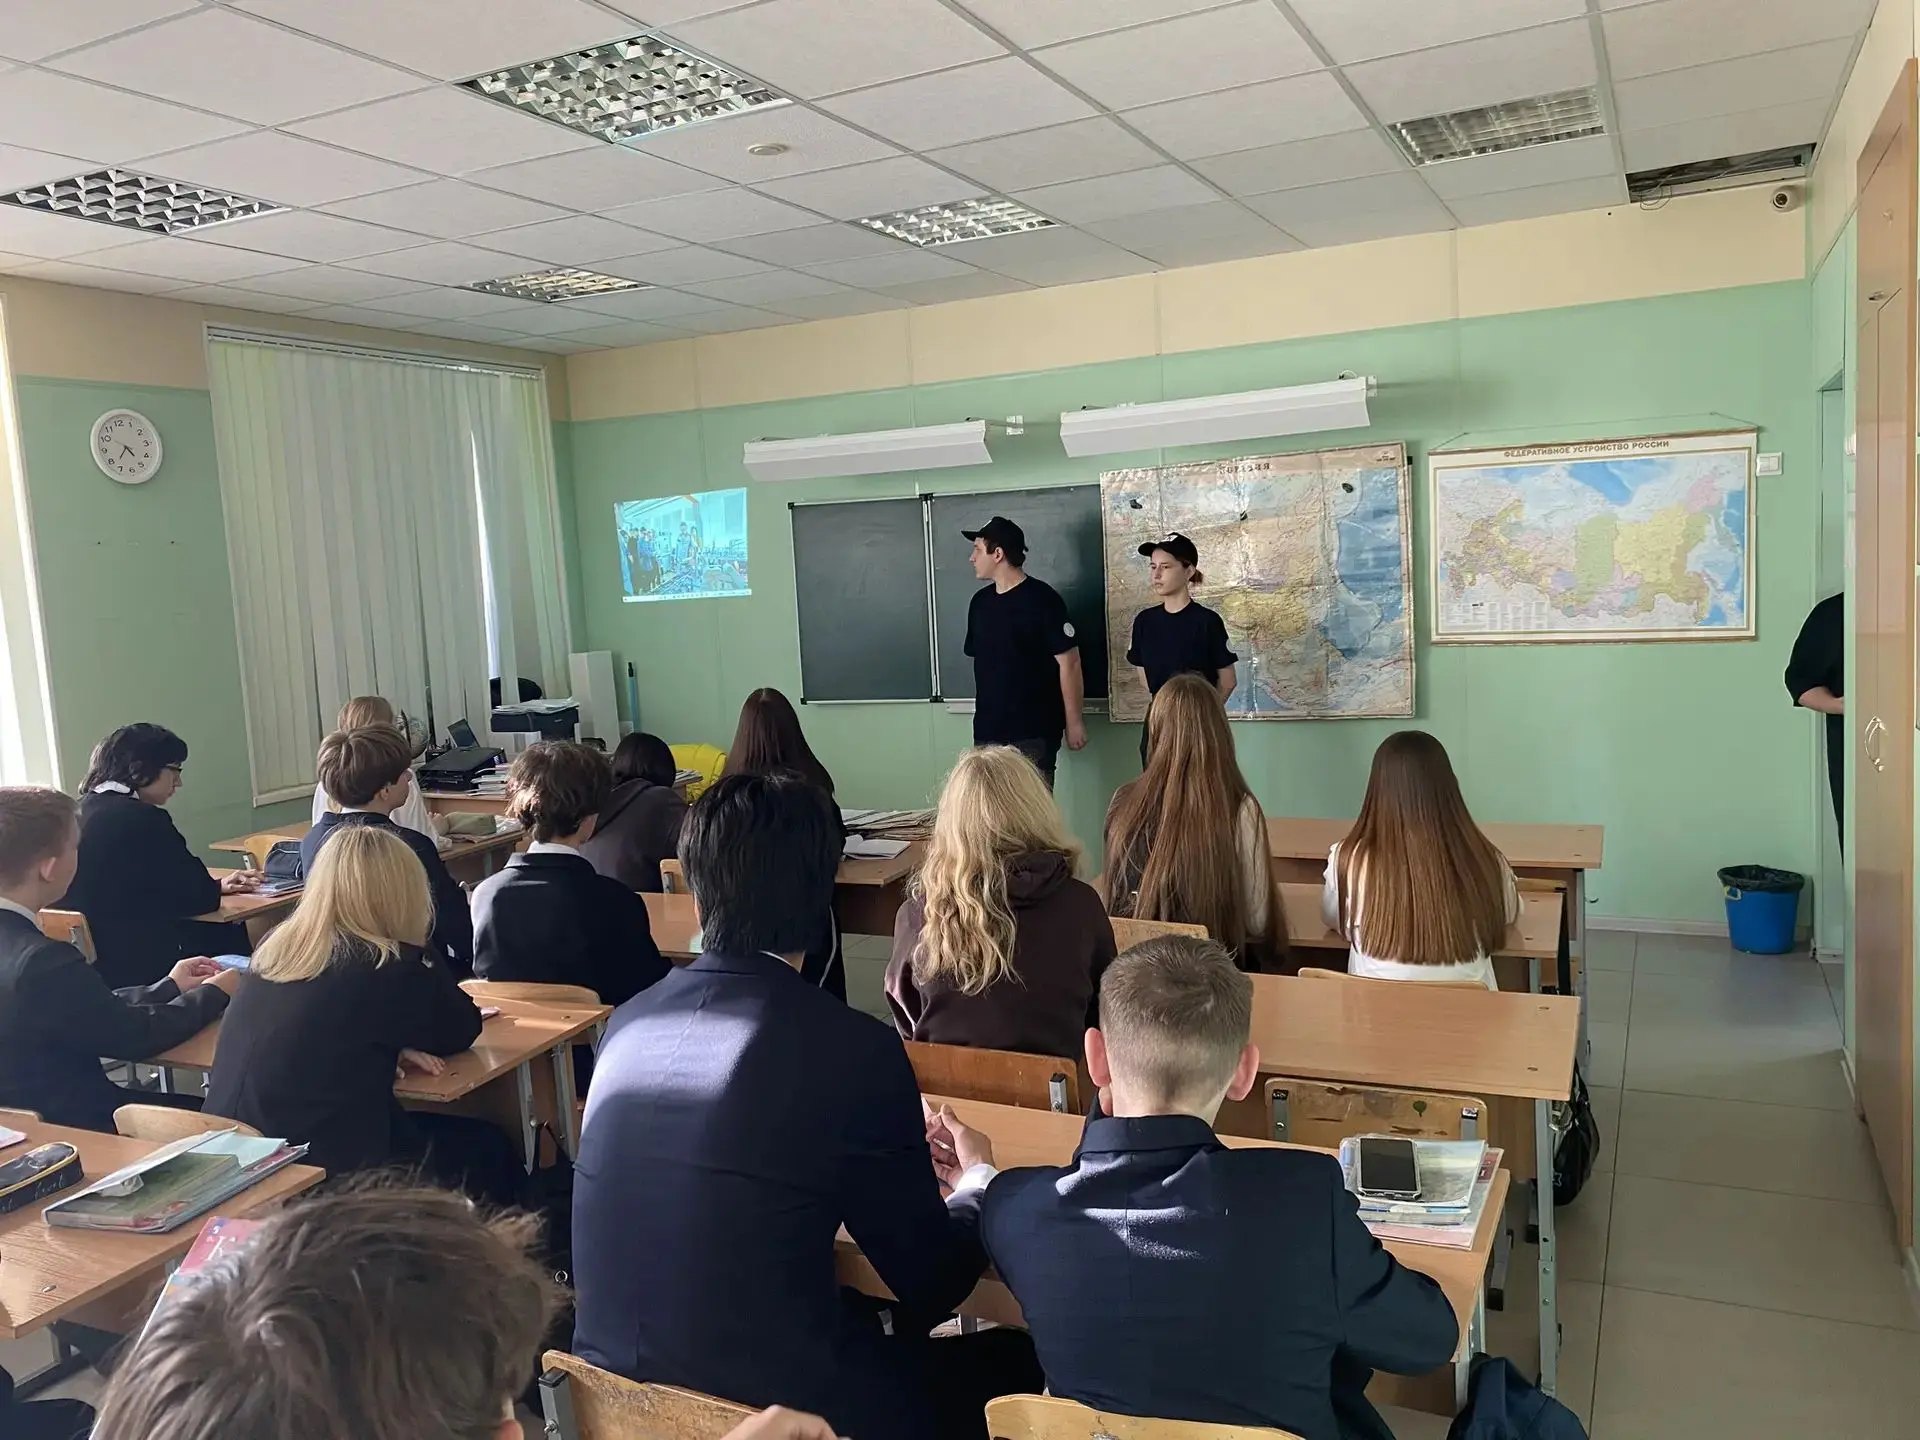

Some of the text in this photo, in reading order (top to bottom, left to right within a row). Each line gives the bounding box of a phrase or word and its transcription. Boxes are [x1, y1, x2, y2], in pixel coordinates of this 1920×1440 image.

[114, 419, 125, 427] 12
[137, 428, 143, 436] 2
[101, 434, 111, 443] 10
[1504, 446, 1571, 457] ФЕДЕРАТИВНОЕ
[1631, 440, 1670, 449] РОССИИ
